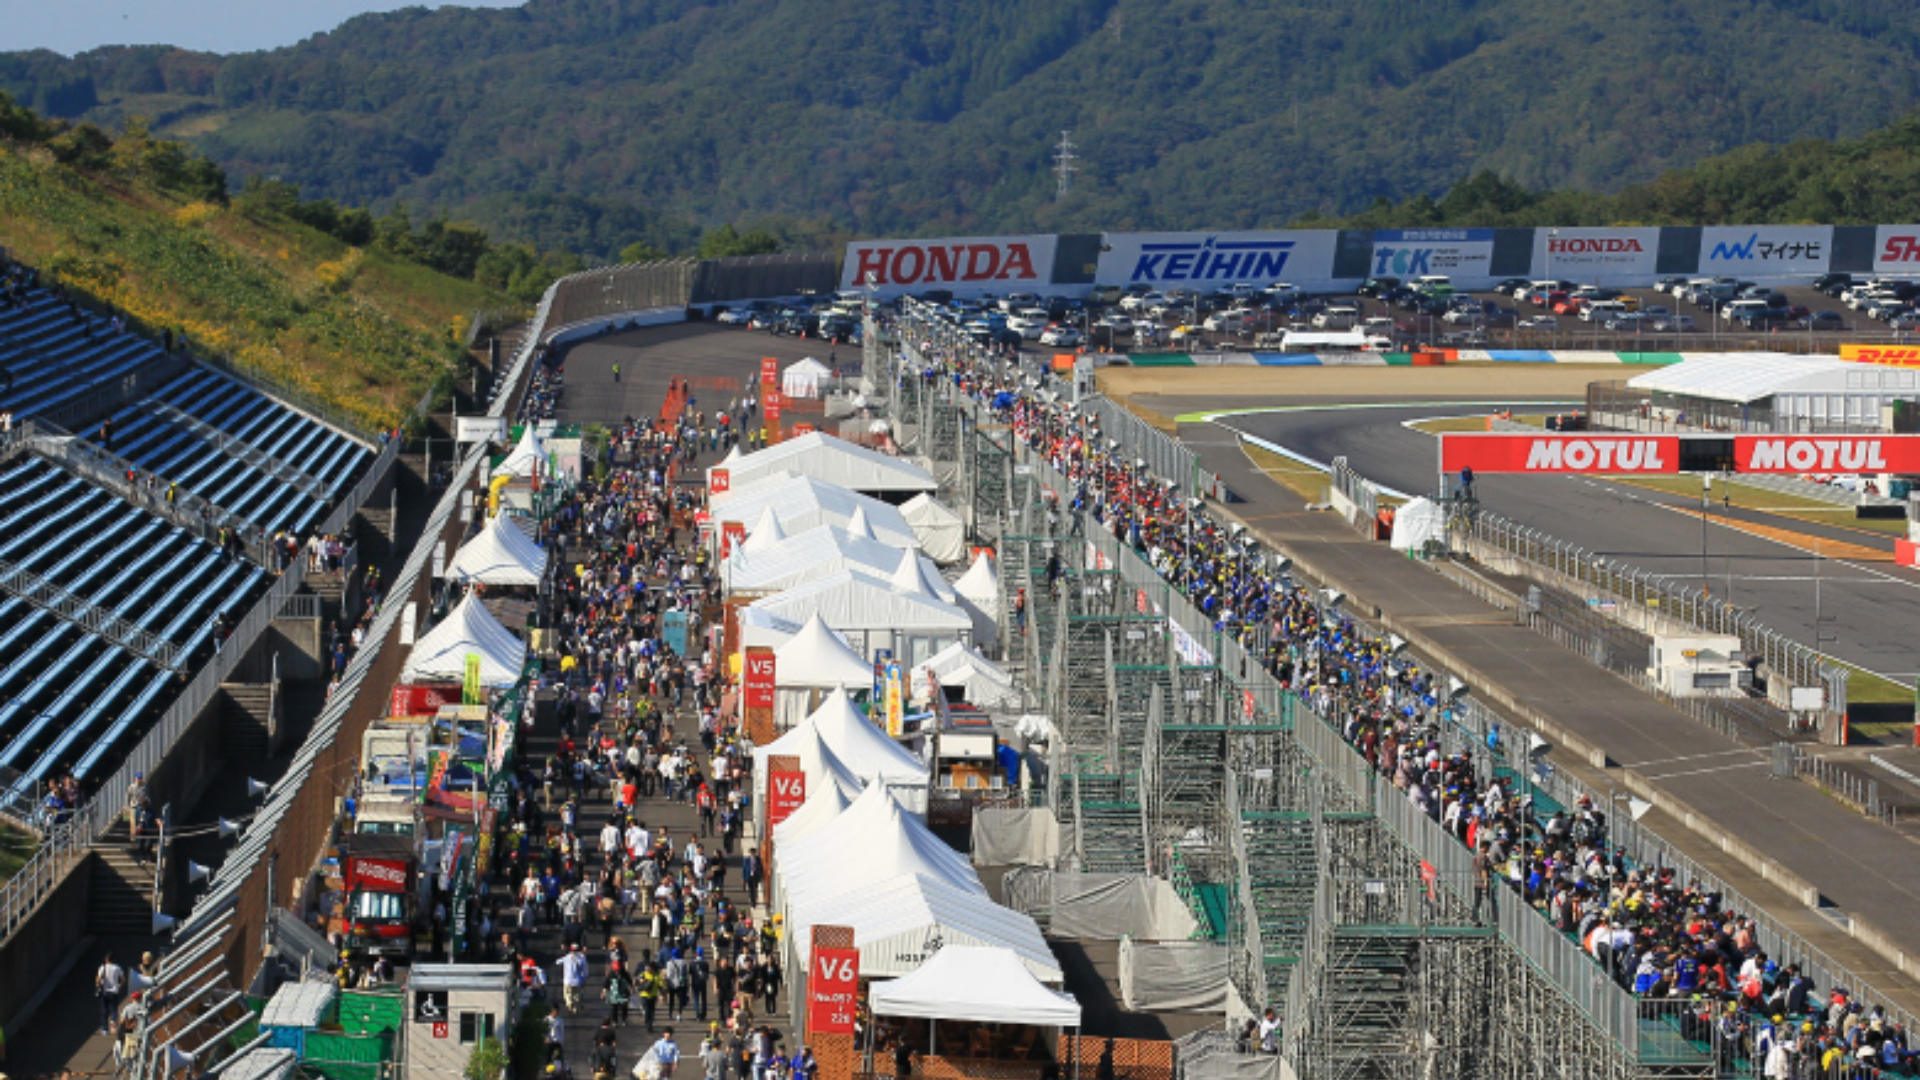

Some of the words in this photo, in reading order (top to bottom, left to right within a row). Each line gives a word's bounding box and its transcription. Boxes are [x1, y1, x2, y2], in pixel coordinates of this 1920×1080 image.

[1548, 238, 1643, 252] HONDA
[1757, 241, 1820, 260] マイナビ
[852, 243, 1037, 287] HONDA
[1130, 248, 1289, 281] KEIHIN
[1525, 439, 1664, 470] MOTUL
[1750, 439, 1887, 471] MOTUL
[750, 659, 773, 675] V5
[775, 777, 803, 797] V6
[820, 956, 855, 982] V6
